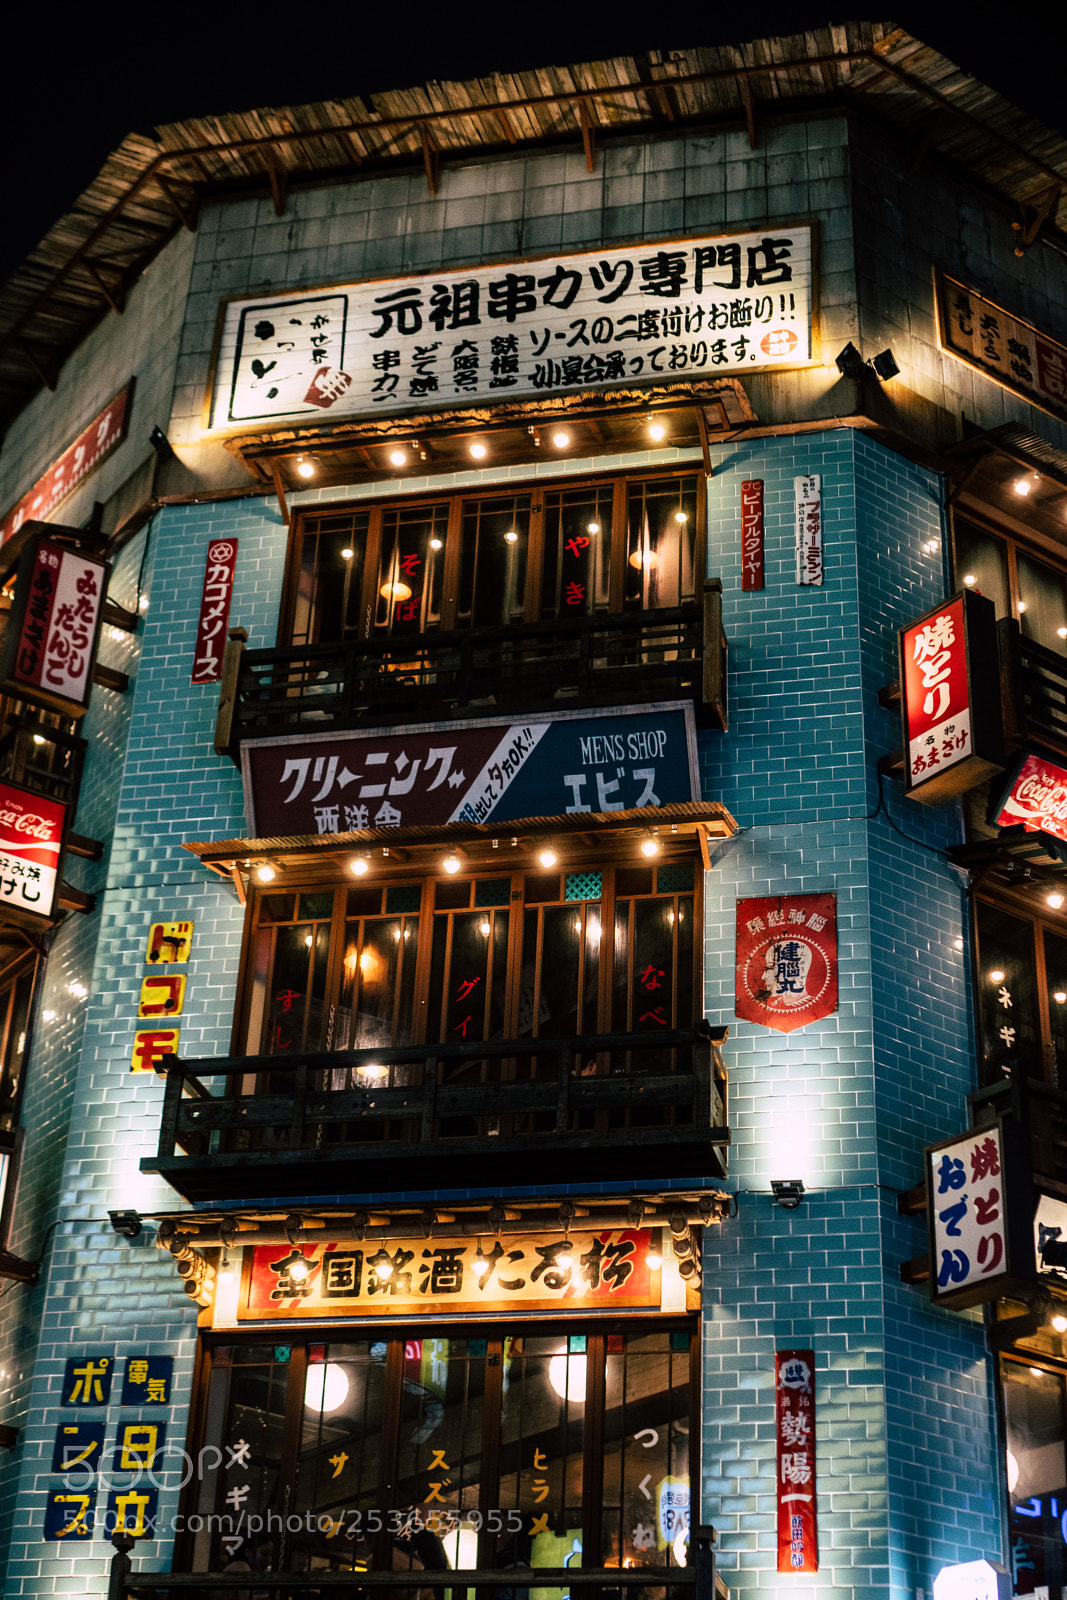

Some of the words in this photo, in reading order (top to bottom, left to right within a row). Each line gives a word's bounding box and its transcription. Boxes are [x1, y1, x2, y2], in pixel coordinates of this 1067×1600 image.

[369, 237, 794, 338] 元祖串カツ専門店
[67, 570, 97, 678] みたらし
[195, 563, 231, 678] カゴメソース
[396, 553, 421, 621] そば
[46, 603, 75, 685] だんご
[913, 615, 956, 721] 焼とり
[280, 746, 466, 804] クリーニング
[579, 733, 625, 765] MENS
[627, 729, 668, 761] SHOP
[912, 728, 969, 776] あまざけ
[925, 724, 956, 746] 名物
[563, 766, 662, 814] エビス
[276, 989, 301, 1049] すし
[639, 964, 667, 1025] なべ
[937, 1154, 971, 1288] おでん
[970, 1137, 1003, 1274] 焼とり
[128, 1359, 166, 1402] 電気
[54, 1358, 109, 1538] ポンプ
[632, 1427, 660, 1550] つくね
[221, 1438, 252, 1557] ネギマ
[528, 1448, 550, 1537] ヒラメ
